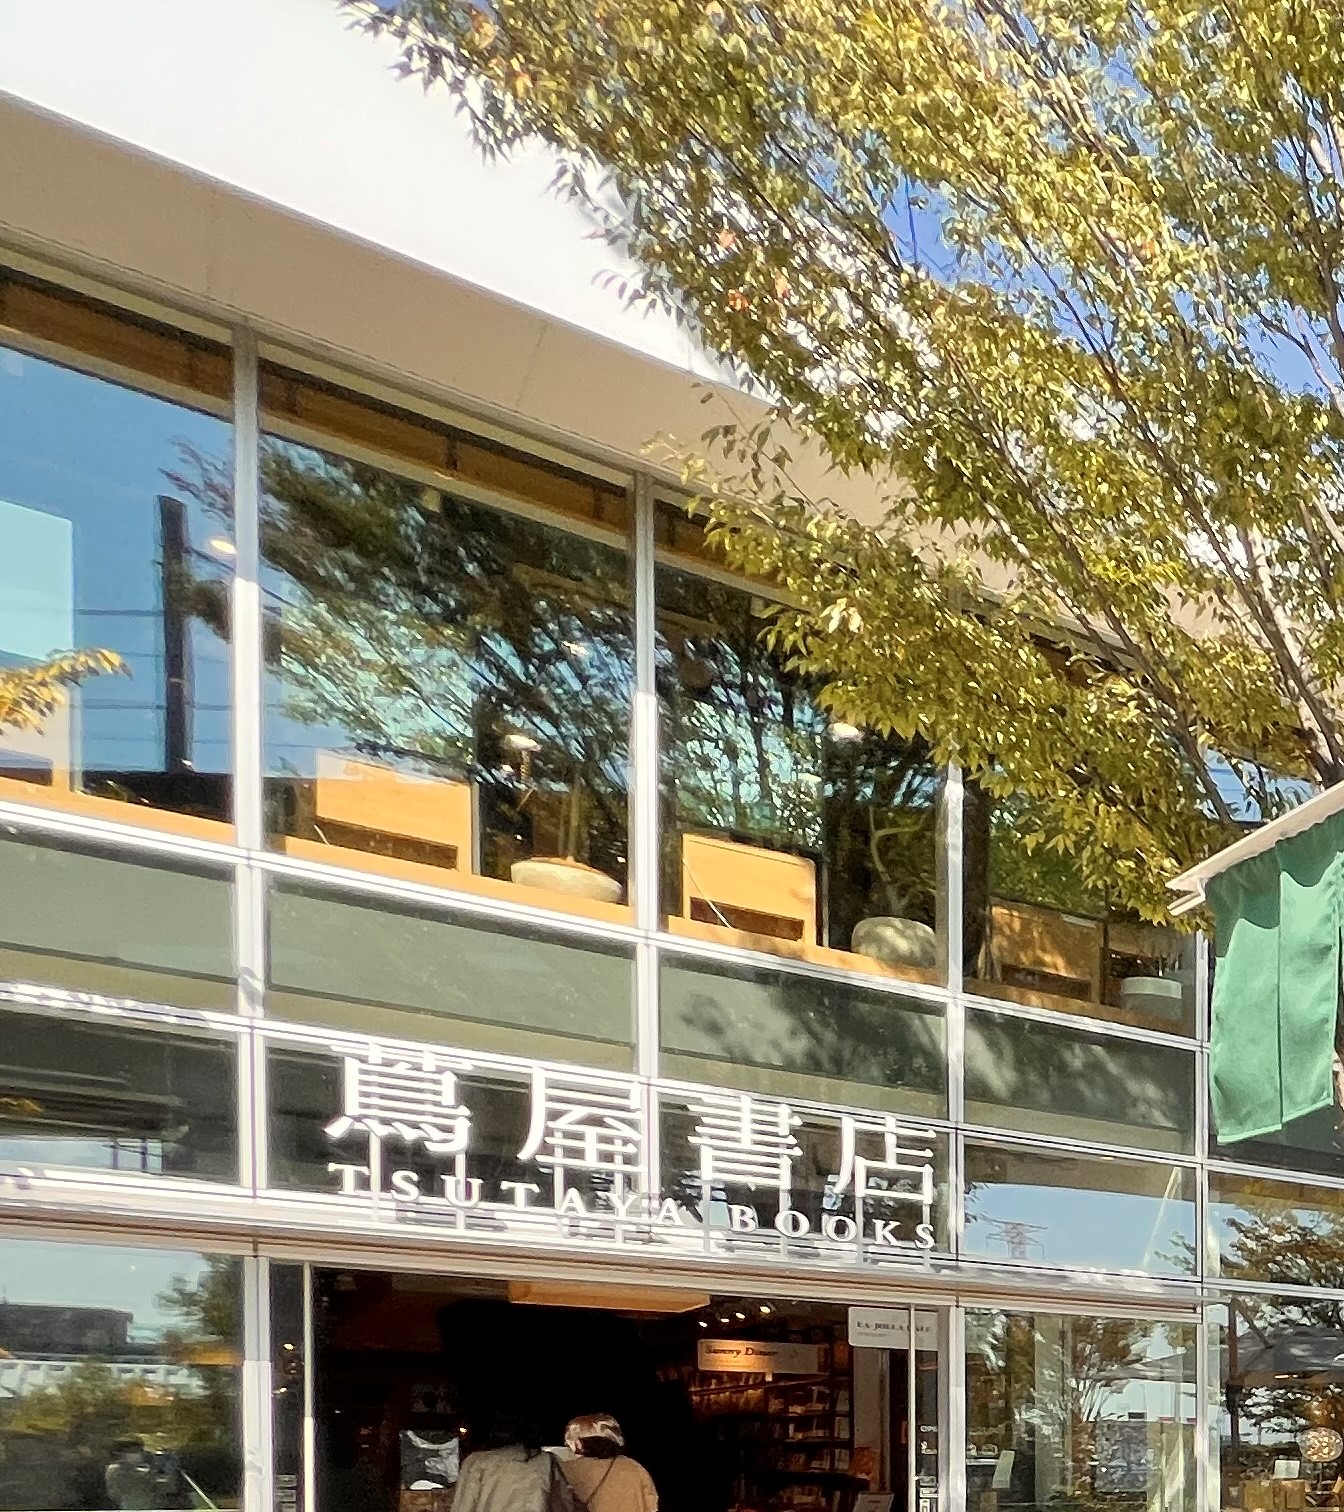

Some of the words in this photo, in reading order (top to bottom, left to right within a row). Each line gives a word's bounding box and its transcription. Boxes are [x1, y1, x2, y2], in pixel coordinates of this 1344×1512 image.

[323, 1043, 937, 1206] 蔦屋書店
[327, 1163, 685, 1226] TSUTAYA
[729, 1203, 936, 1249] BOOKS
